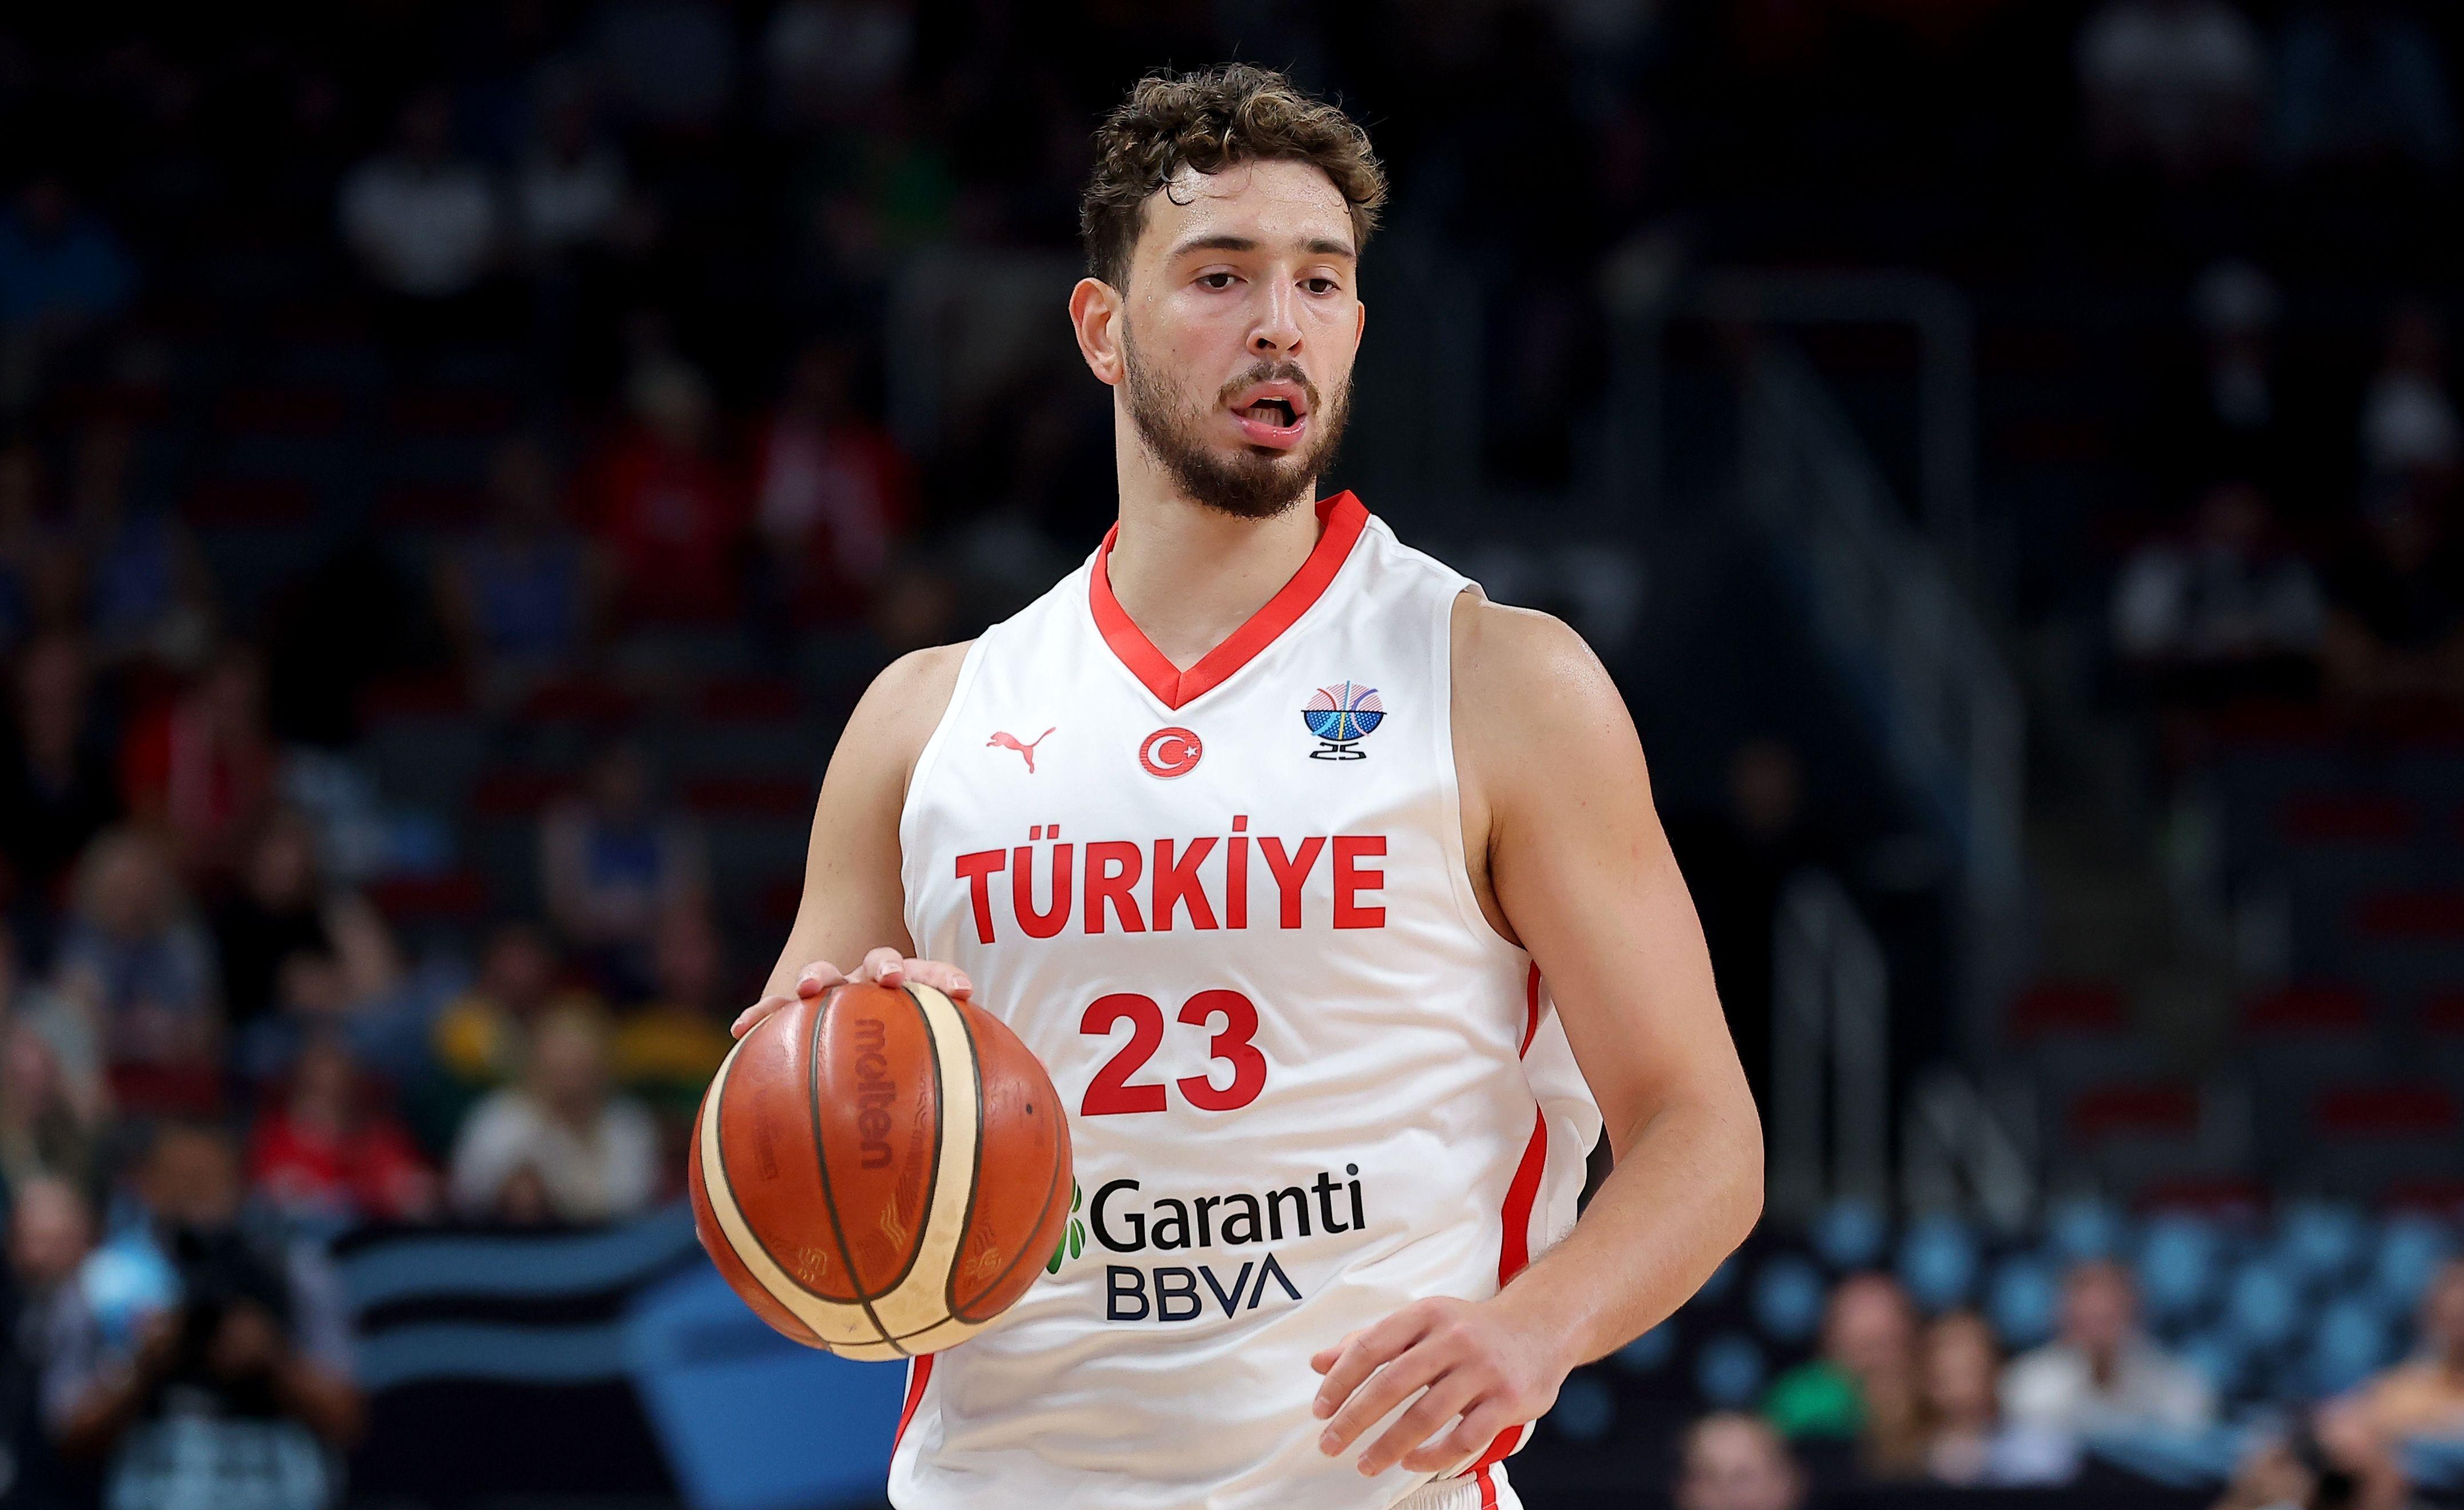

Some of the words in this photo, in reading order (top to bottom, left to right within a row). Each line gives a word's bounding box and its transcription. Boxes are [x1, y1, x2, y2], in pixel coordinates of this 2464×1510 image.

[955, 814, 1387, 945] TÜRKİYE
[855, 1019, 897, 1170] molten
[1079, 989, 1267, 1117] 23
[1089, 1162, 1366, 1253] Garanti
[1106, 1251, 1303, 1322] BBVA
